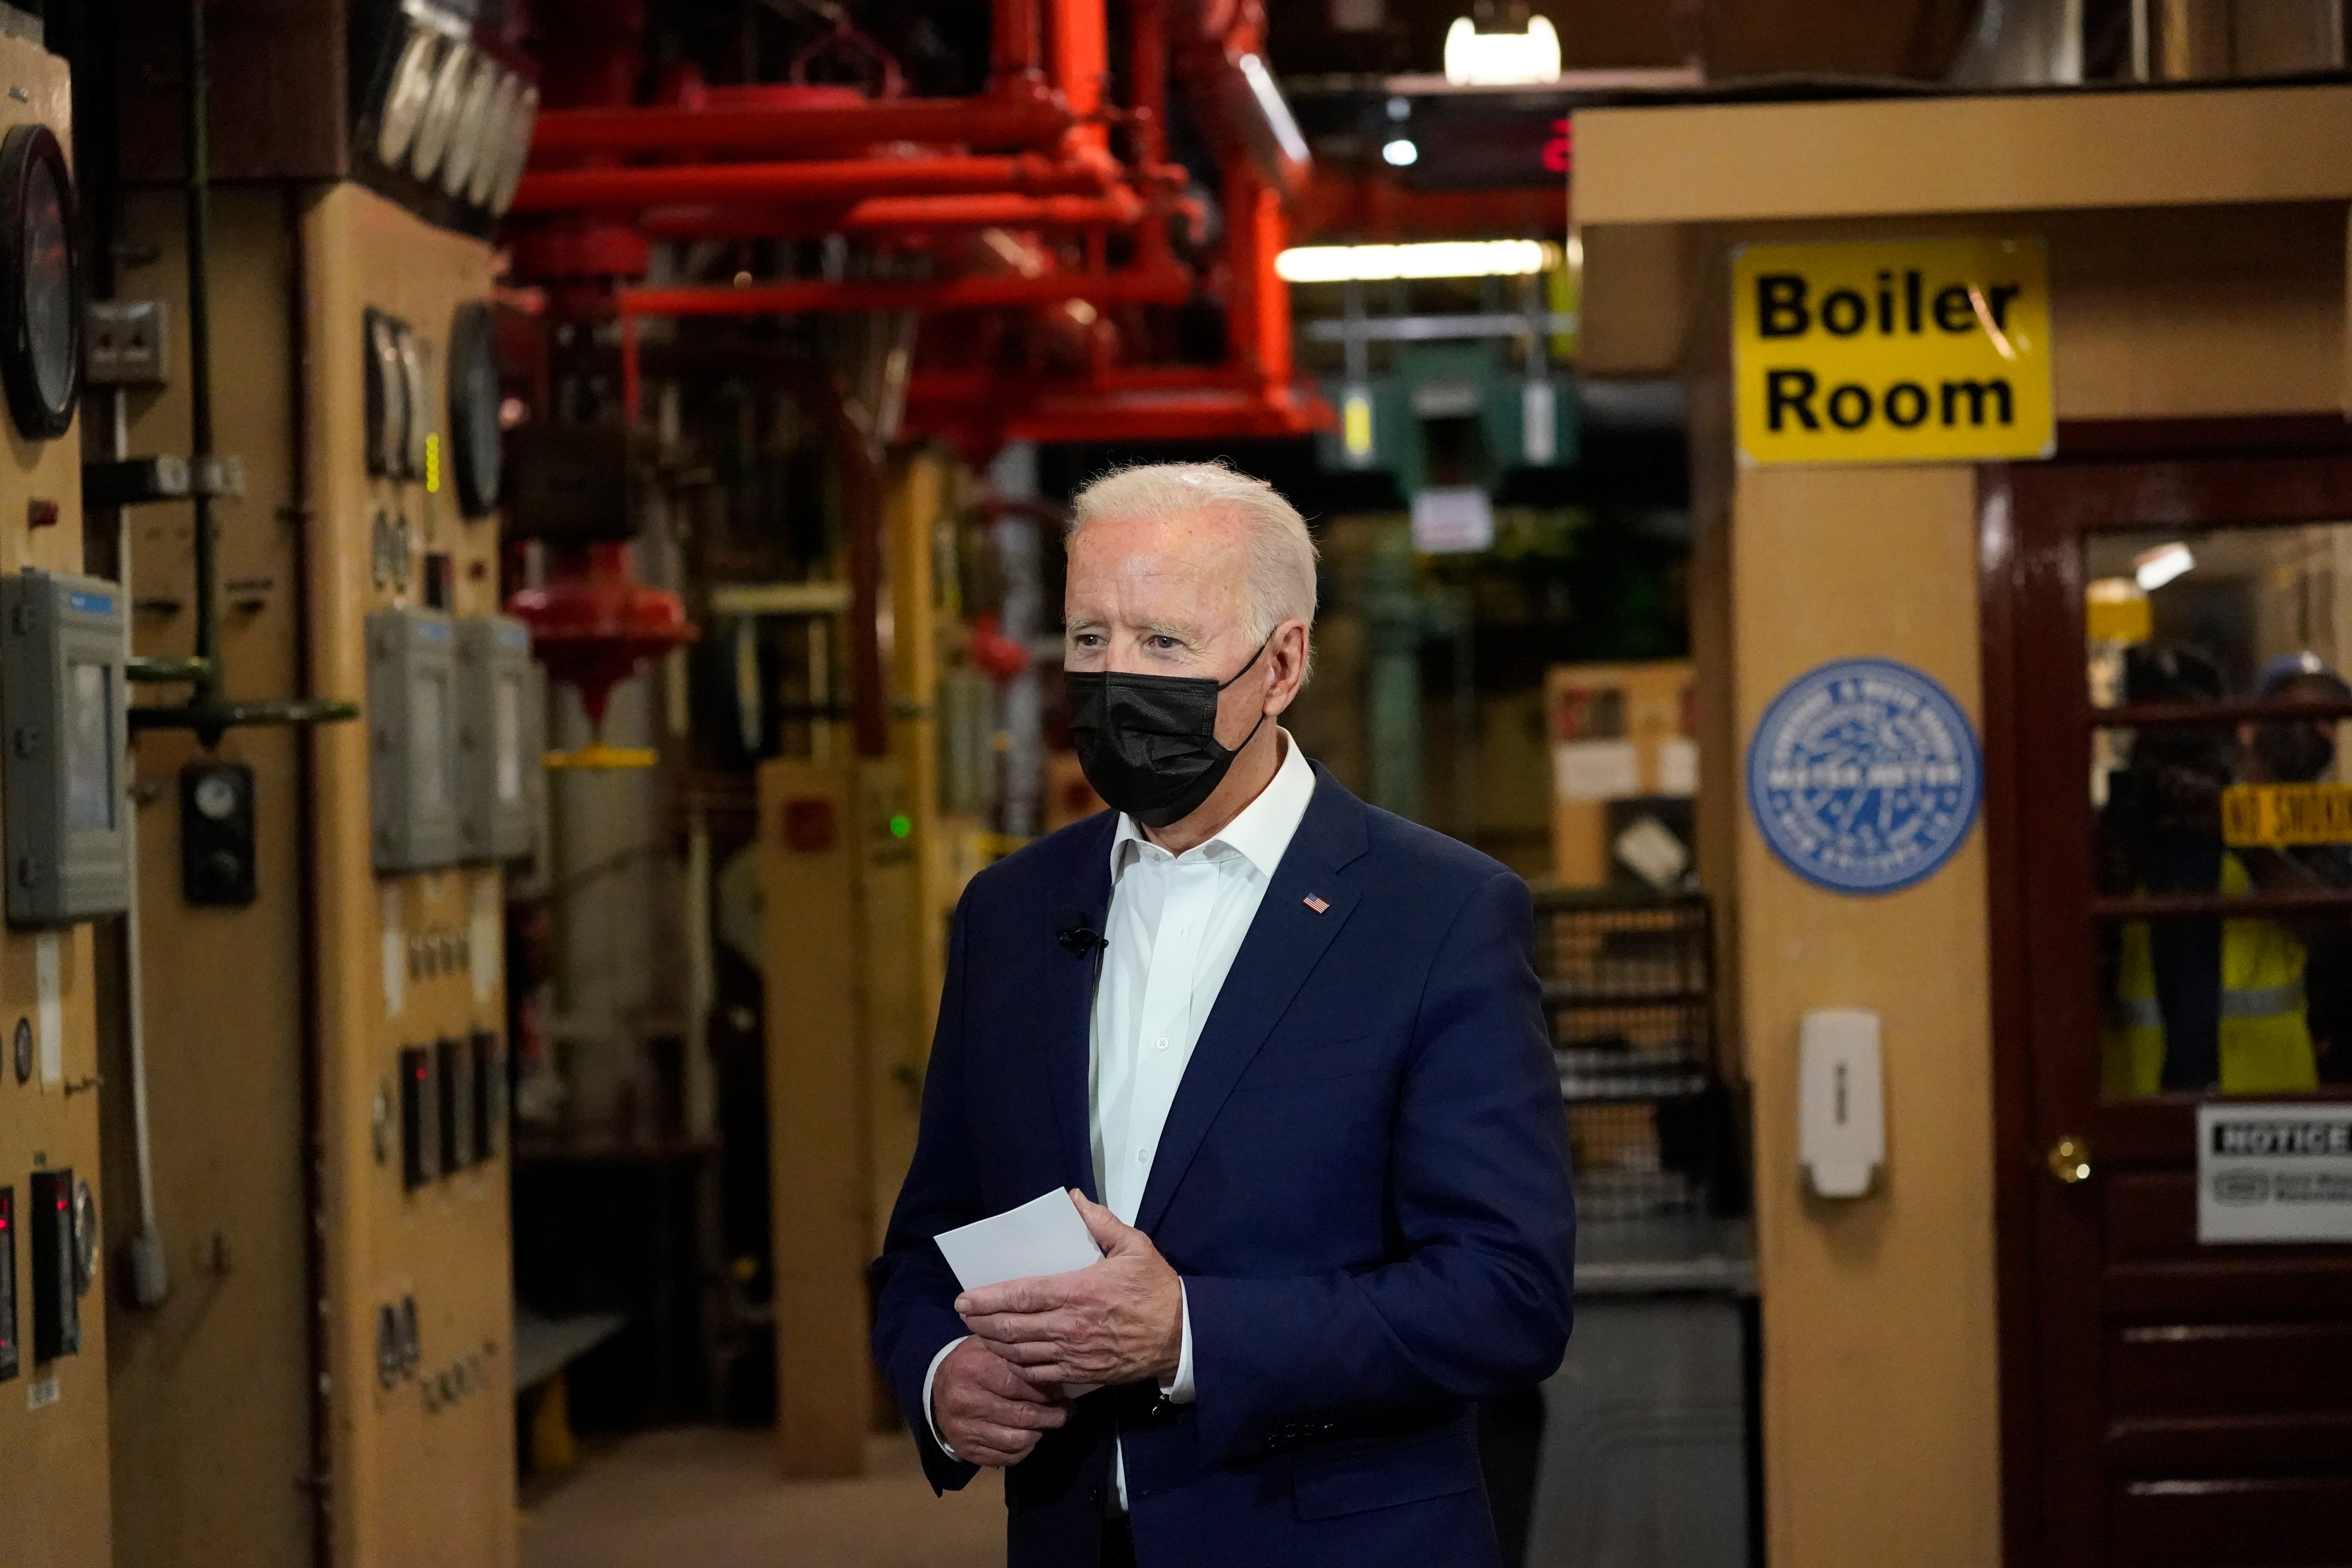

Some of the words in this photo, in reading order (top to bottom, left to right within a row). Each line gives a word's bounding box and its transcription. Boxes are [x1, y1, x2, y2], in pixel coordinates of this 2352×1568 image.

[1756, 270, 2020, 337] Boiler
[1766, 368, 2014, 431] Room
[2225, 1127, 2347, 1150] NOTICE
